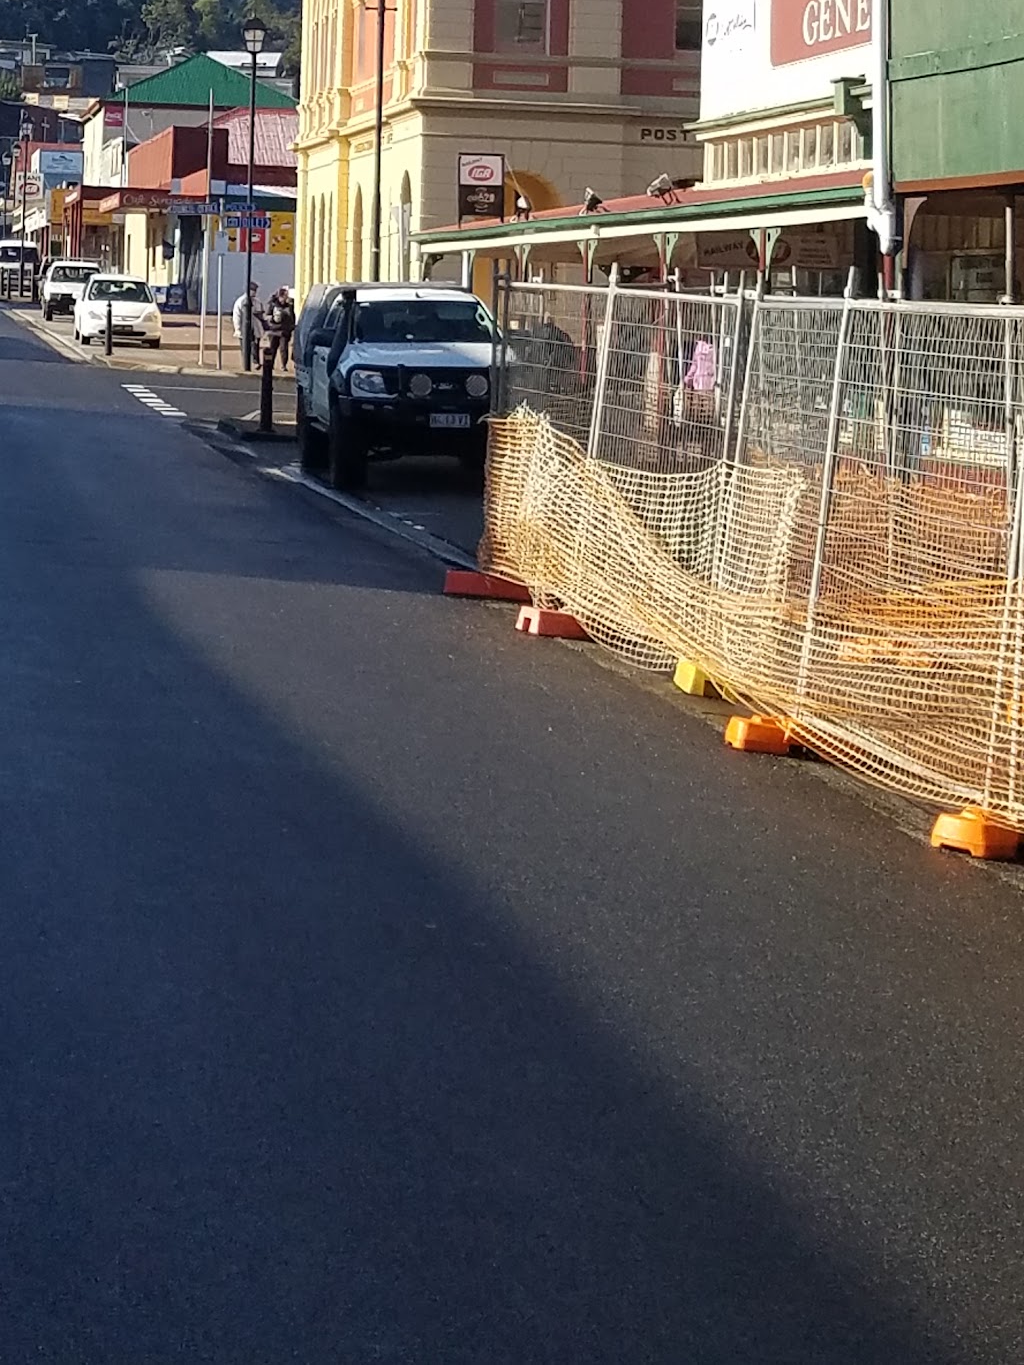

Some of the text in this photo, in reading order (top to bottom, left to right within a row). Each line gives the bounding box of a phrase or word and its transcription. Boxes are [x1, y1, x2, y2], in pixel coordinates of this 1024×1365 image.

[641, 128, 691, 141] POST
[471, 168, 493, 178] IGA
[704, 241, 744, 255] RAILWAY
